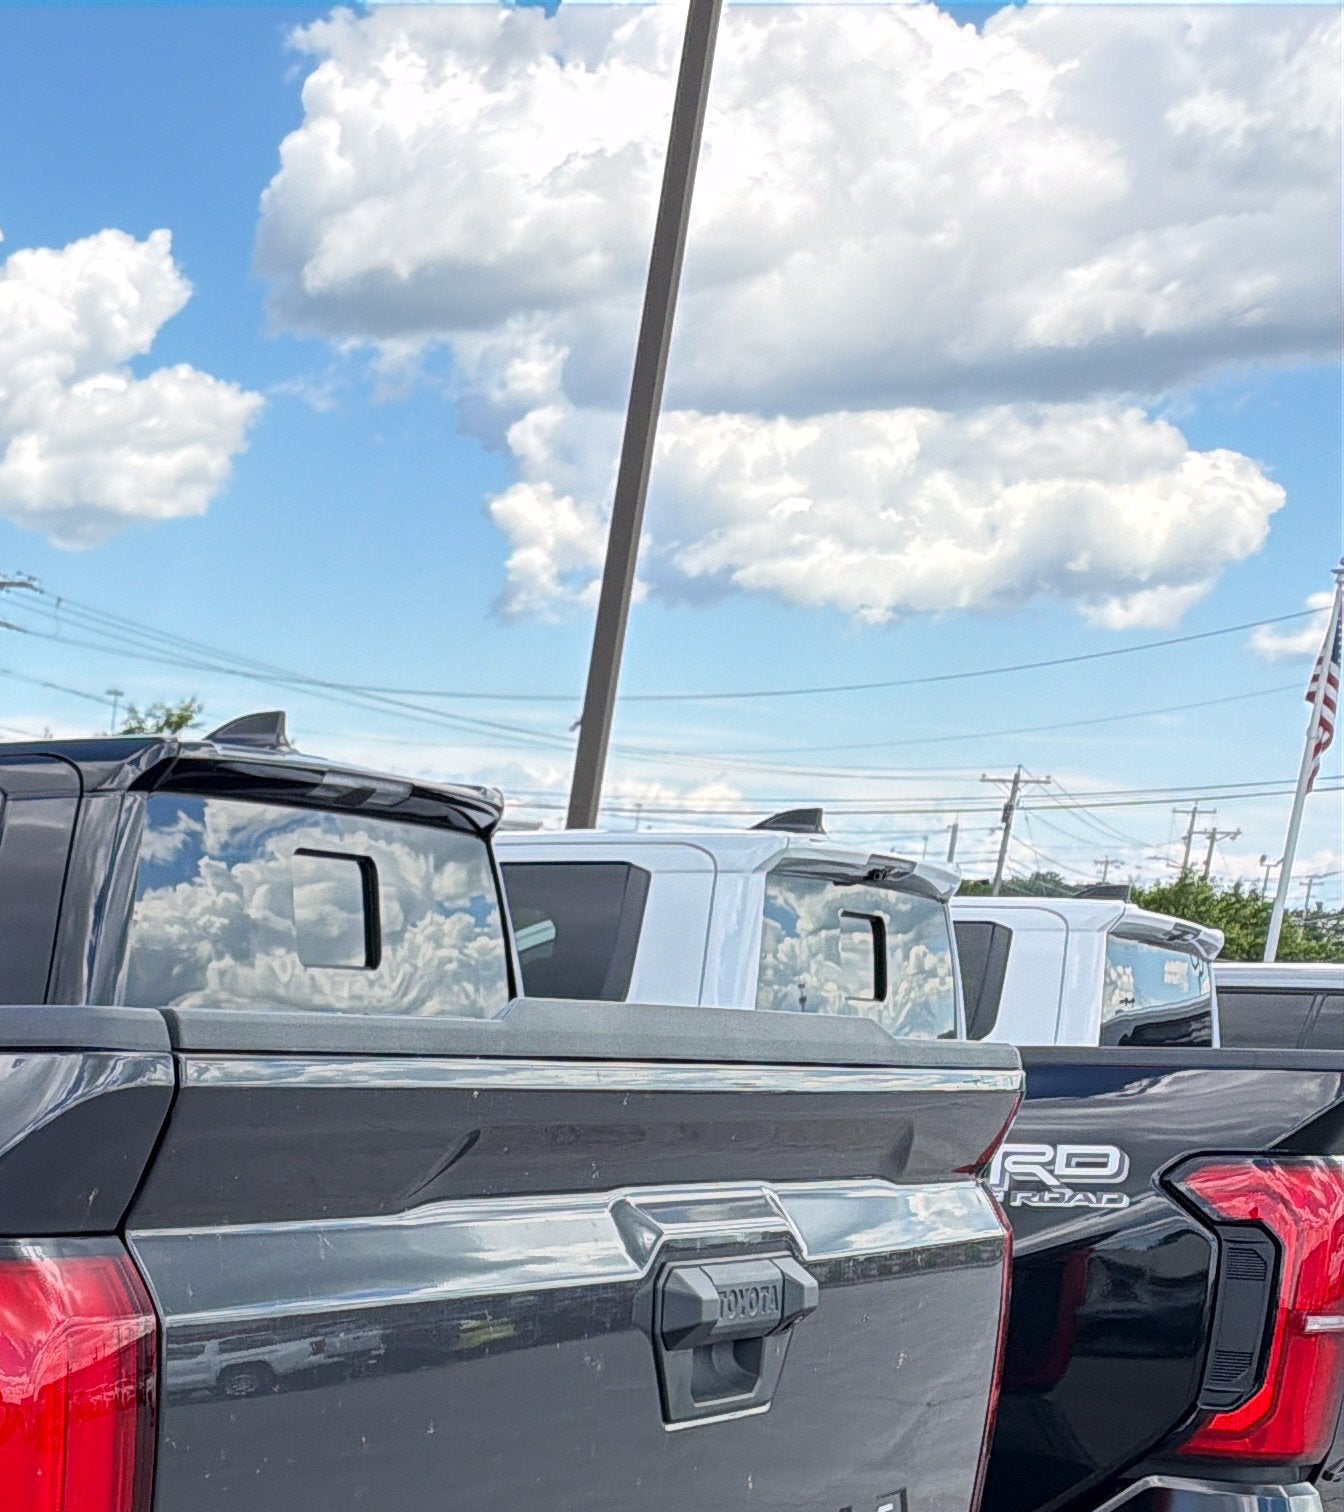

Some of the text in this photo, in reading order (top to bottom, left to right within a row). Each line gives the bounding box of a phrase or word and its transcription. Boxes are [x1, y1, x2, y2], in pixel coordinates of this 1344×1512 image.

[989, 1143, 1130, 1192] RD
[1010, 1191, 1131, 1208] ROAD
[718, 1283, 780, 1322] TOYOTA
